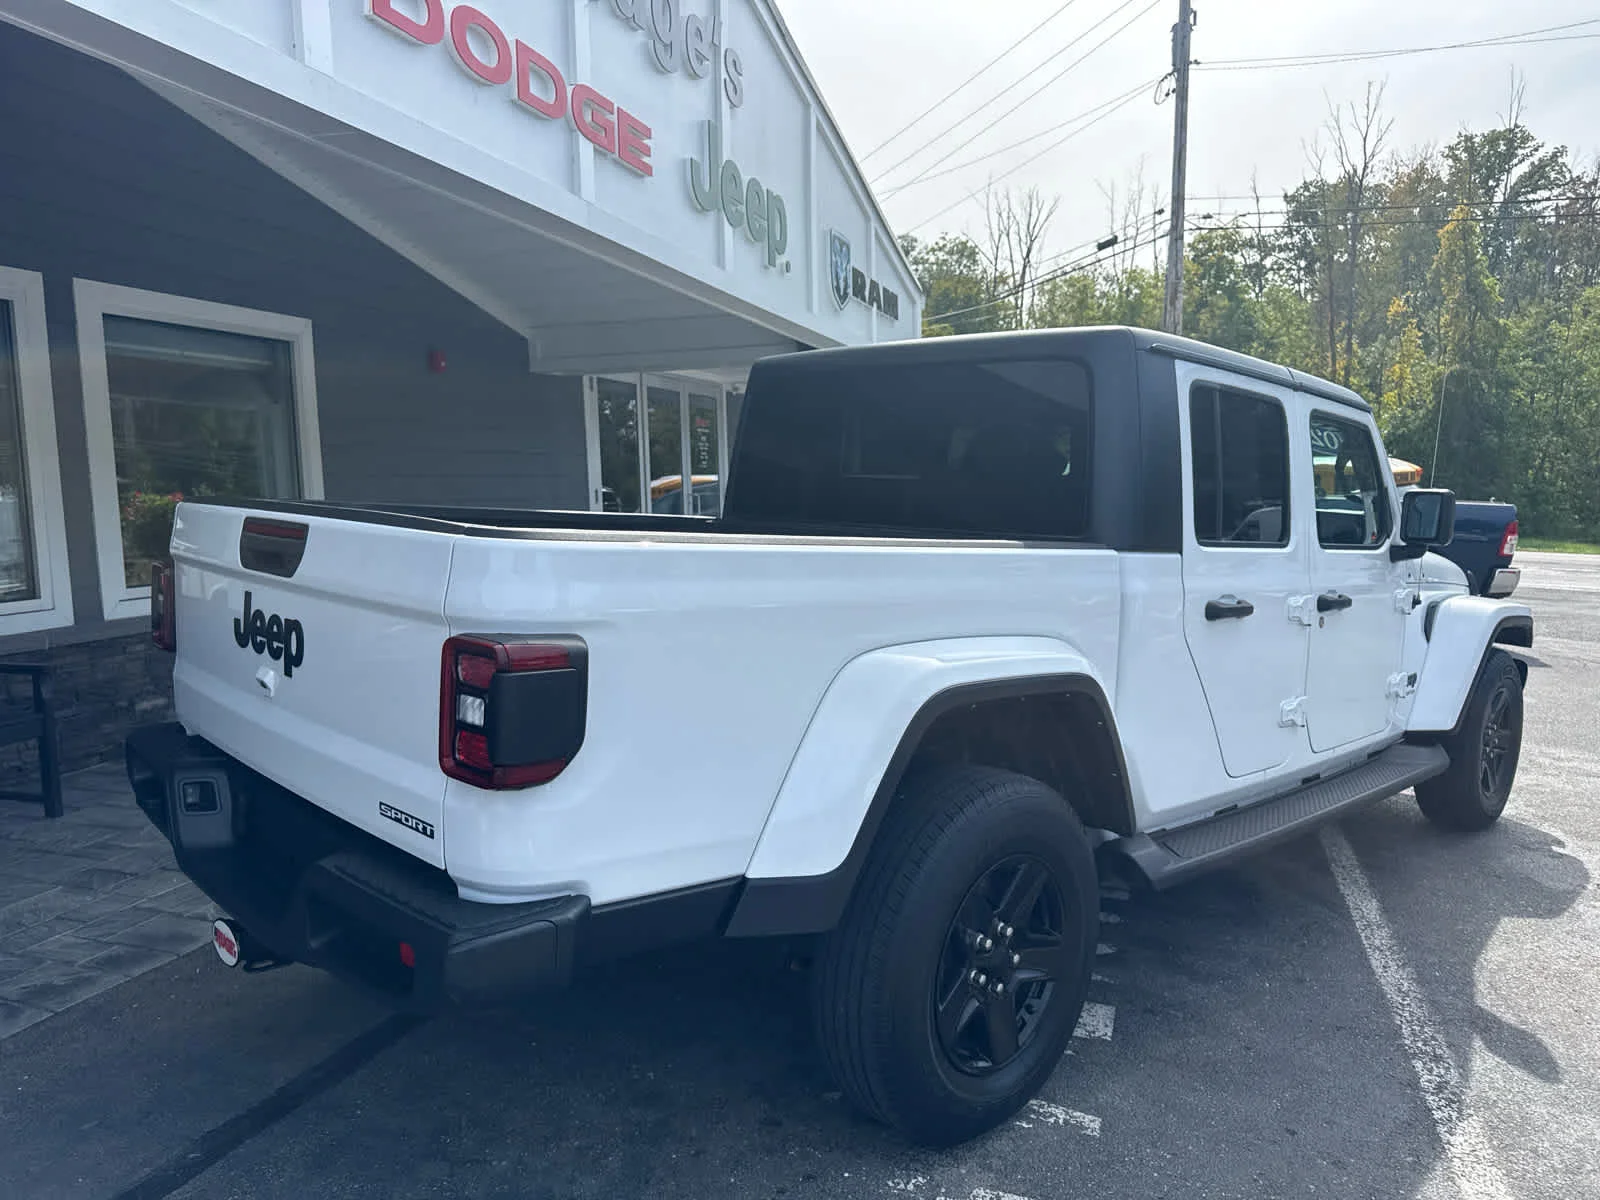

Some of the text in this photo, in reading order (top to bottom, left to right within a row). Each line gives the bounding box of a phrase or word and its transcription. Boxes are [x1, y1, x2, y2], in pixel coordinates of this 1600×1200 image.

[851, 266, 899, 321] RAM
[233, 590, 305, 679] Jeep
[379, 802, 435, 838] SPORT
